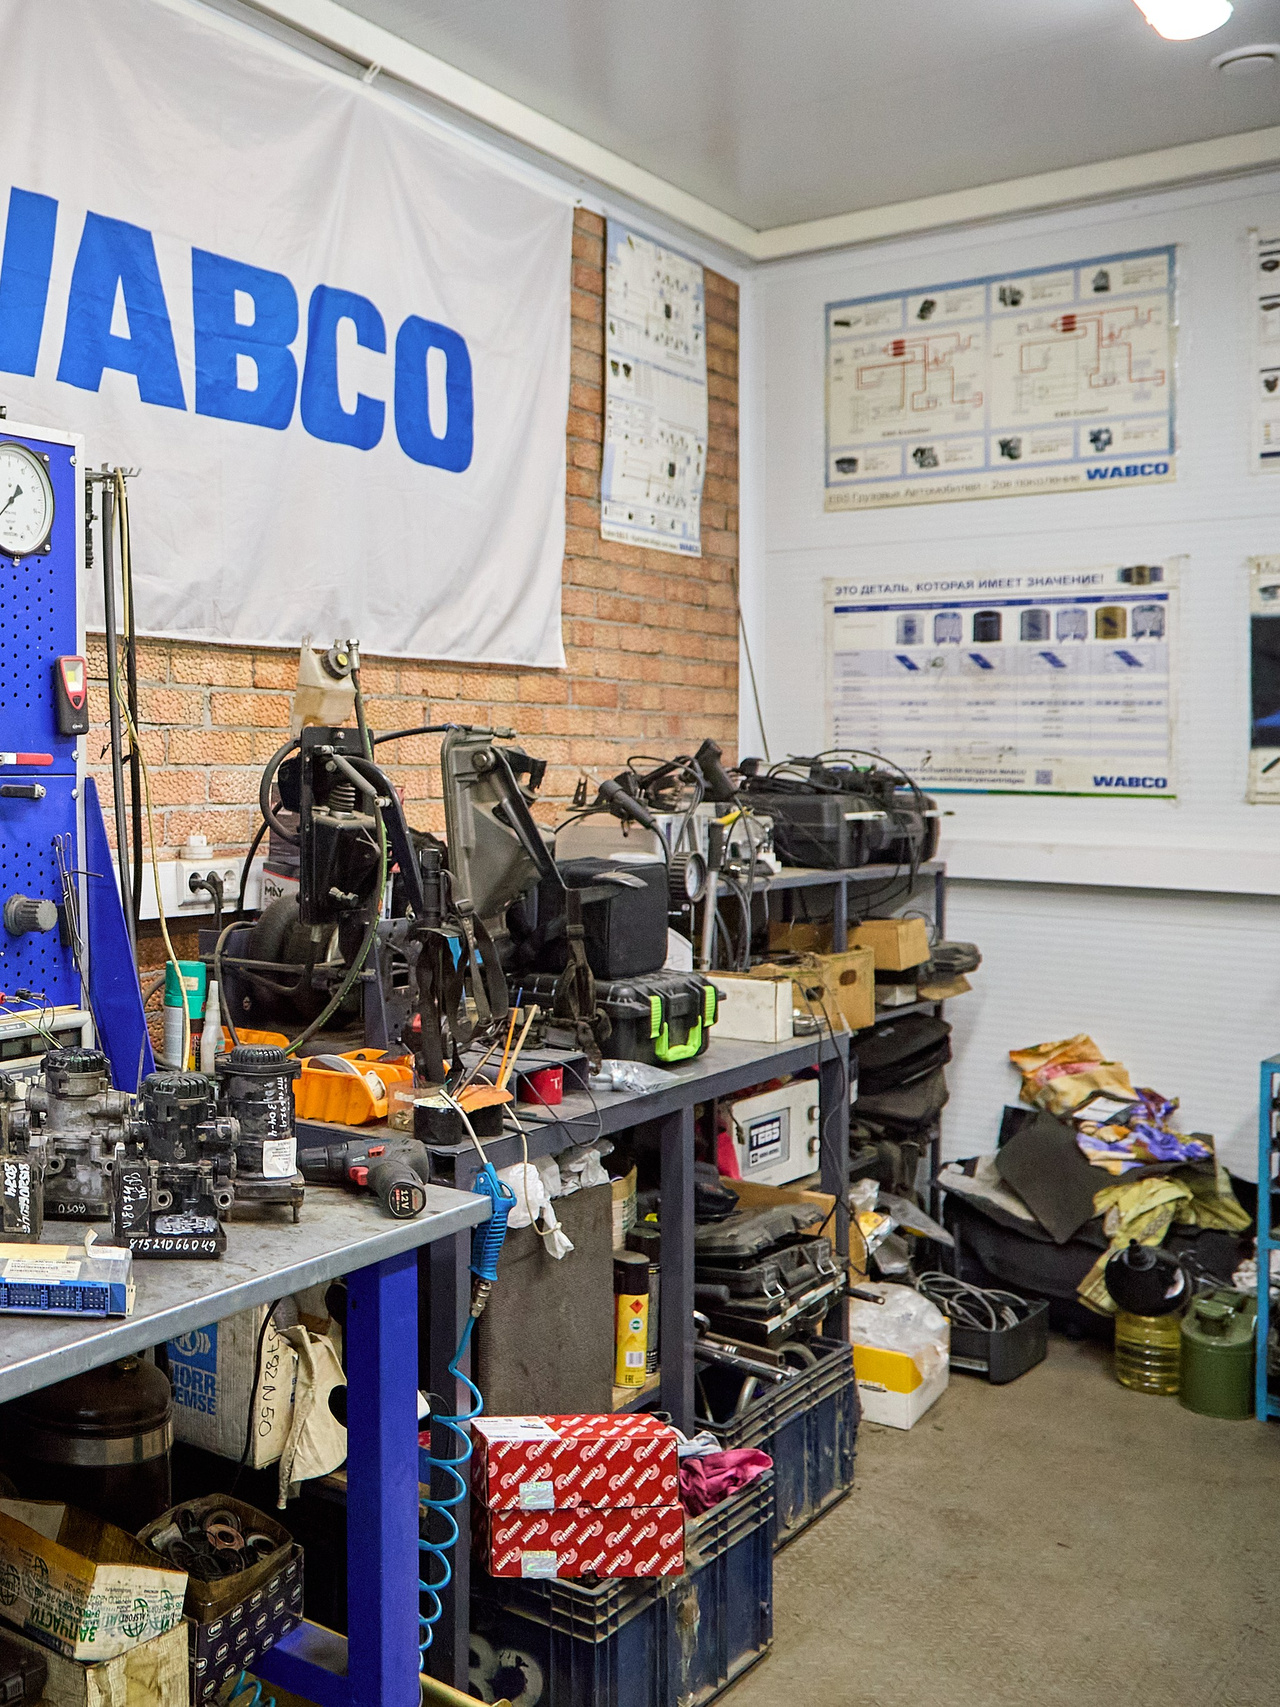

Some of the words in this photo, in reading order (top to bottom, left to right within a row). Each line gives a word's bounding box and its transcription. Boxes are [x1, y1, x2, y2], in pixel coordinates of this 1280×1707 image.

[1086, 462, 1169, 480] WABCO
[835, 585, 858, 596] ЭТО
[860, 583, 913, 596] ДЕТАЛЬ,
[916, 580, 974, 592] КОТОРАЯ
[978, 578, 1022, 589] ИМЕЕТ
[1027, 573, 1104, 587] ЗНАЧЕНИЕ!
[1094, 776, 1167, 788] WABCO
[31, 1606, 98, 1642] ЗАПЧАСТИ
